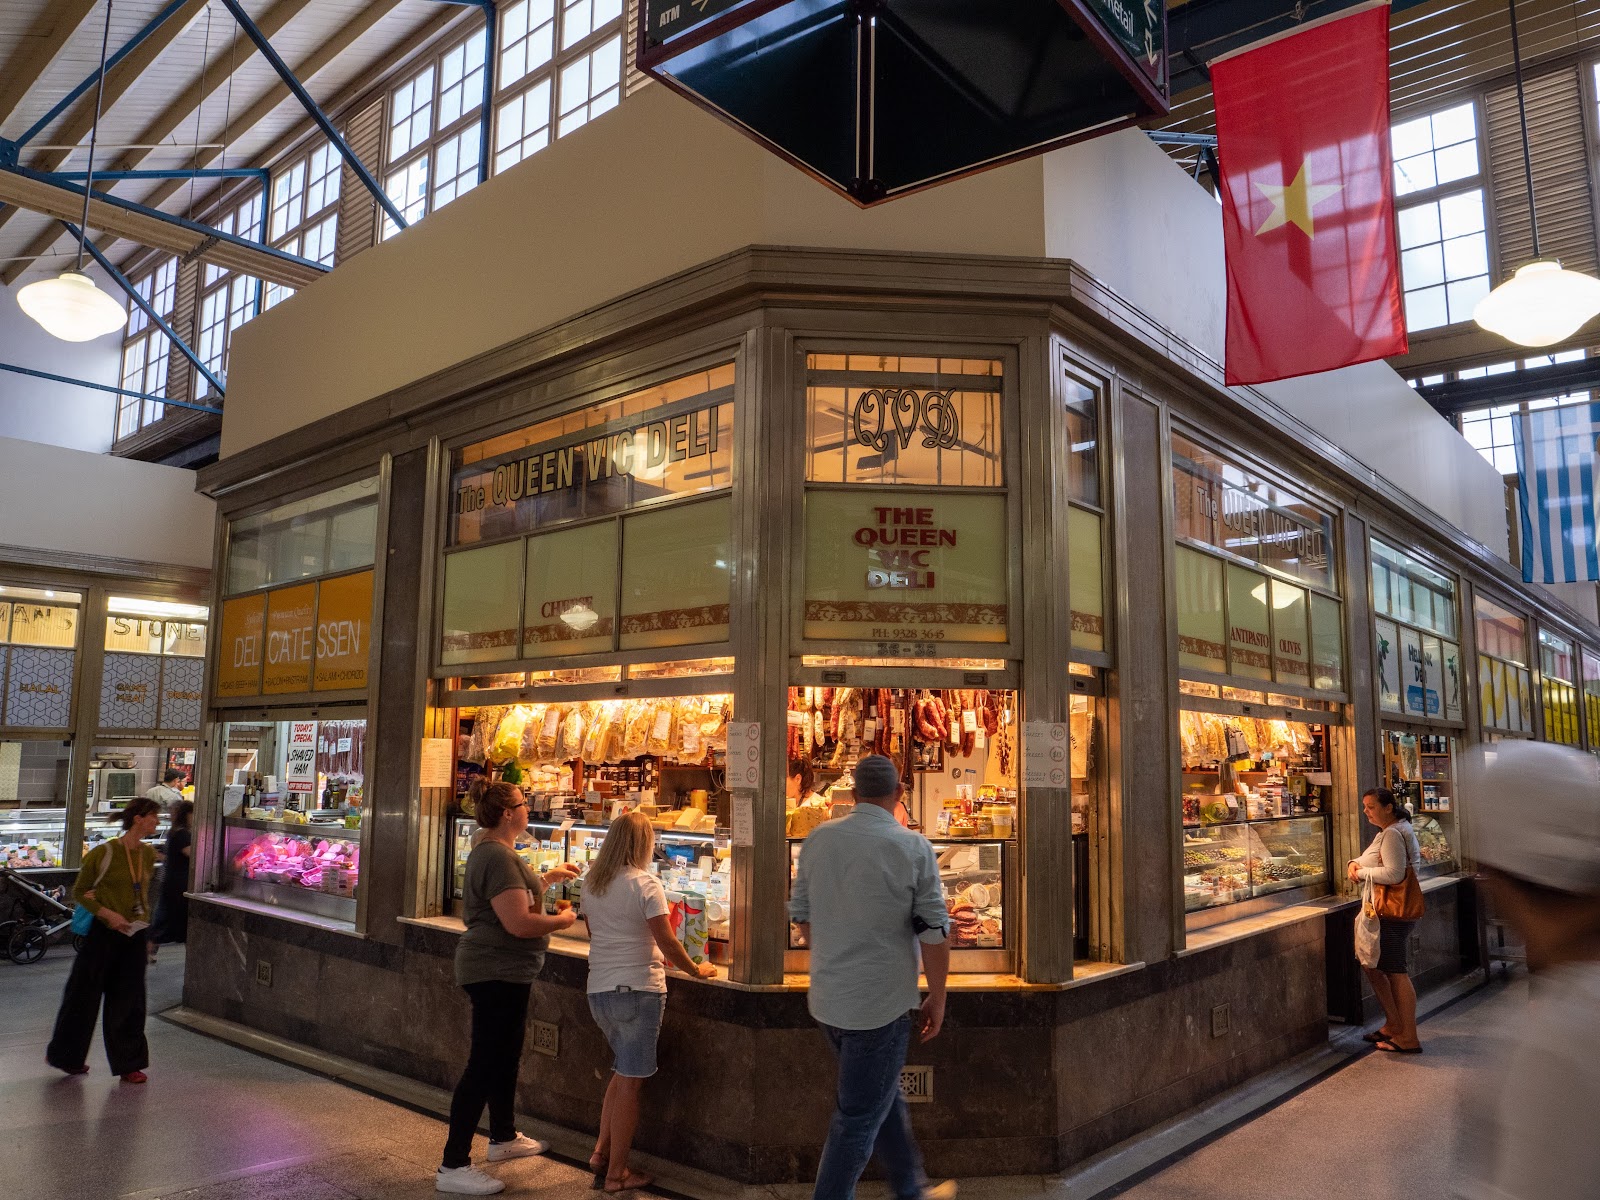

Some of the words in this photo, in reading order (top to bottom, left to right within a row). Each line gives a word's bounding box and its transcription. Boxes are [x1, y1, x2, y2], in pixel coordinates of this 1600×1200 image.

[659, 4, 680, 28] ATM
[853, 388, 959, 452] QVD
[457, 485, 486, 514] The
[492, 447, 574, 507] QUEEN
[586, 429, 635, 481] VIC
[647, 405, 719, 468] DELI
[874, 507, 934, 525] THE
[1197, 485, 1218, 521] The
[1221, 487, 1267, 544] QUEEN
[1272, 512, 1293, 552] VIC
[1297, 524, 1321, 563] DELI
[855, 527, 957, 548] QUEEN
[879, 549, 930, 568] VIC
[867, 570, 935, 589] DELI
[541, 596, 593, 618] CHEESE
[872, 628, 890, 638] PH:
[893, 628, 918, 639] 9328
[921, 629, 945, 640] 3645
[1231, 627, 1270, 648] ANTIPASTO
[234, 619, 360, 668] DELCATESSEN
[1279, 638, 1302, 656] OLIVES
[319, 671, 337, 682] SALAMI
[340, 669, 364, 680] CHORIZO
[20, 683, 61, 694] HALAL
[116, 683, 147, 693] GAME
[115, 694, 146, 703] MEAT
[294, 723, 313, 732] TODAY'S
[293, 734, 313, 742] SPECIAL
[290, 749, 314, 761] SHAVED
[293, 763, 309, 775] HAM
